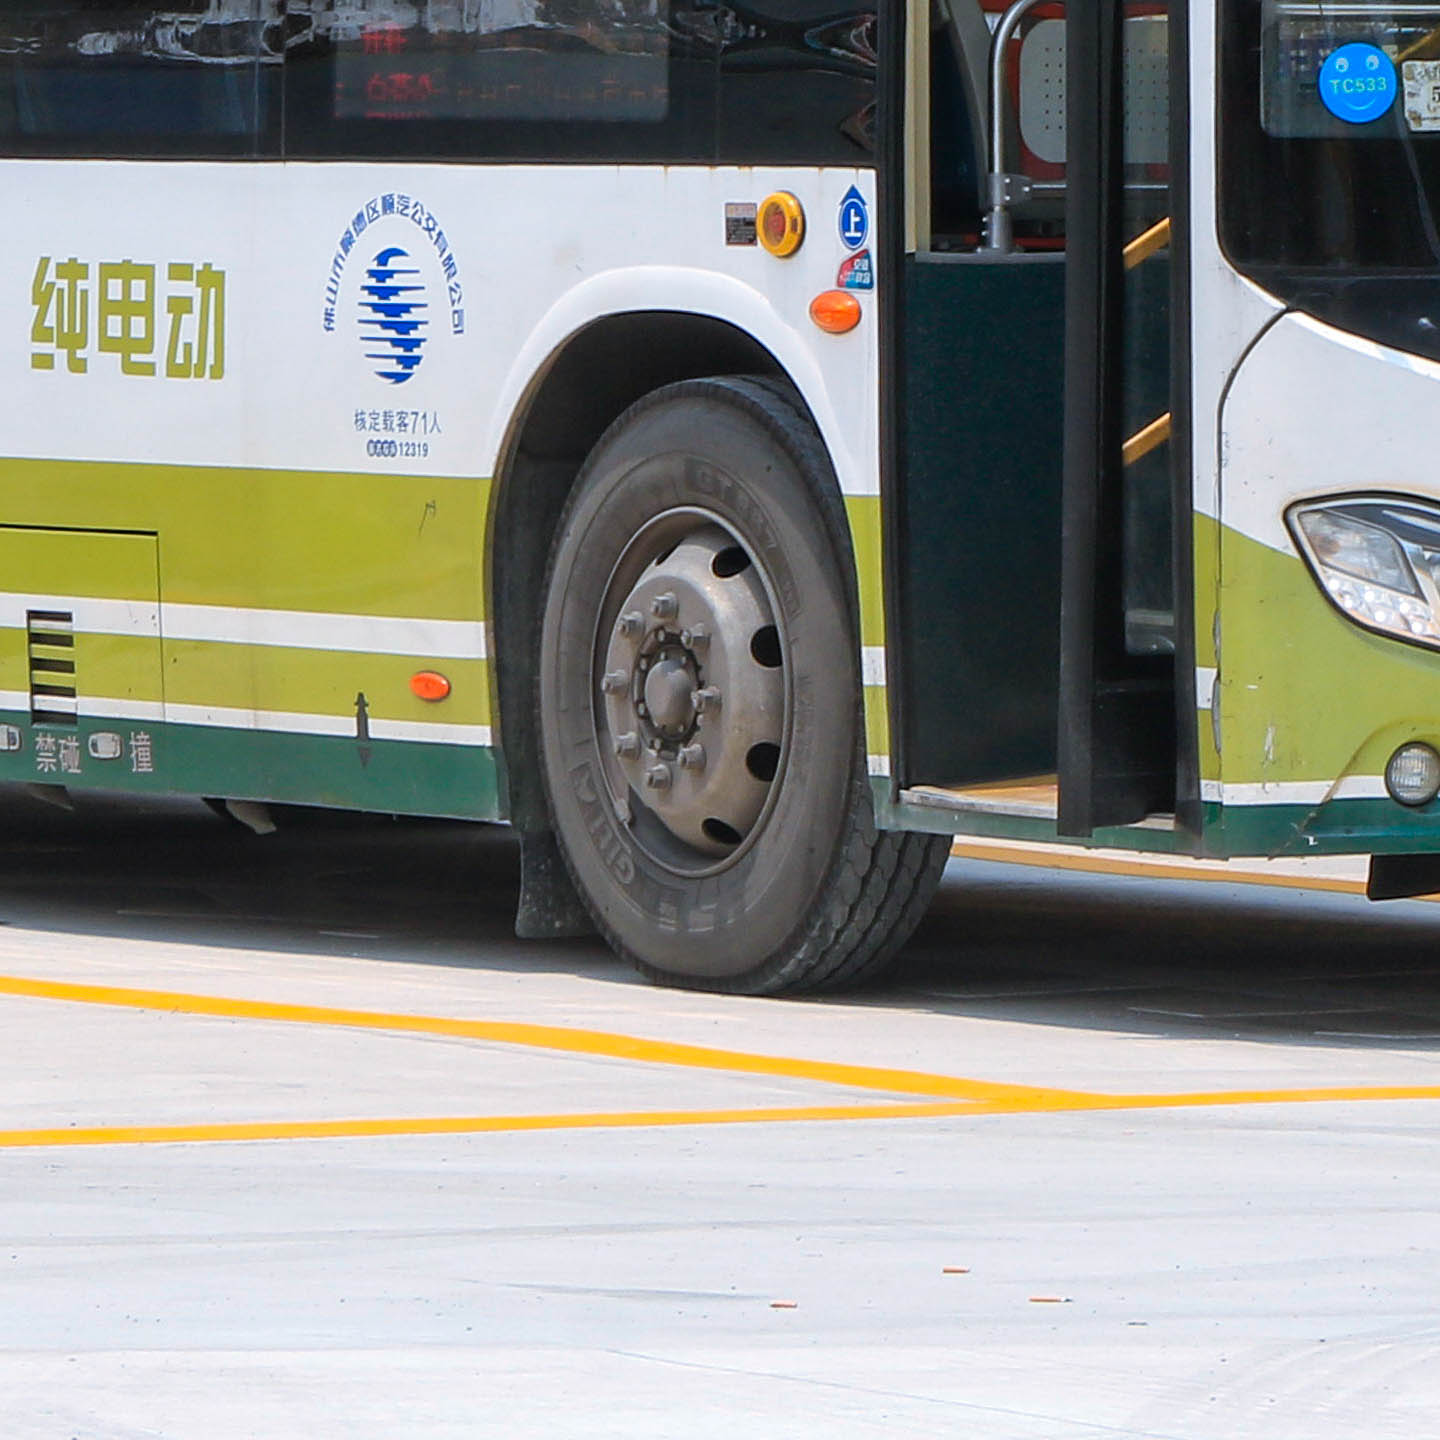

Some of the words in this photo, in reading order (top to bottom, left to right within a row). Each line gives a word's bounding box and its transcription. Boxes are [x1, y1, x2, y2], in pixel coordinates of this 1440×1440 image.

[1328, 76, 1388, 95] TC533
[844, 207, 862, 237] 上
[31, 256, 226, 380] 纯电动
[353, 409, 443, 435] 核定载客71人
